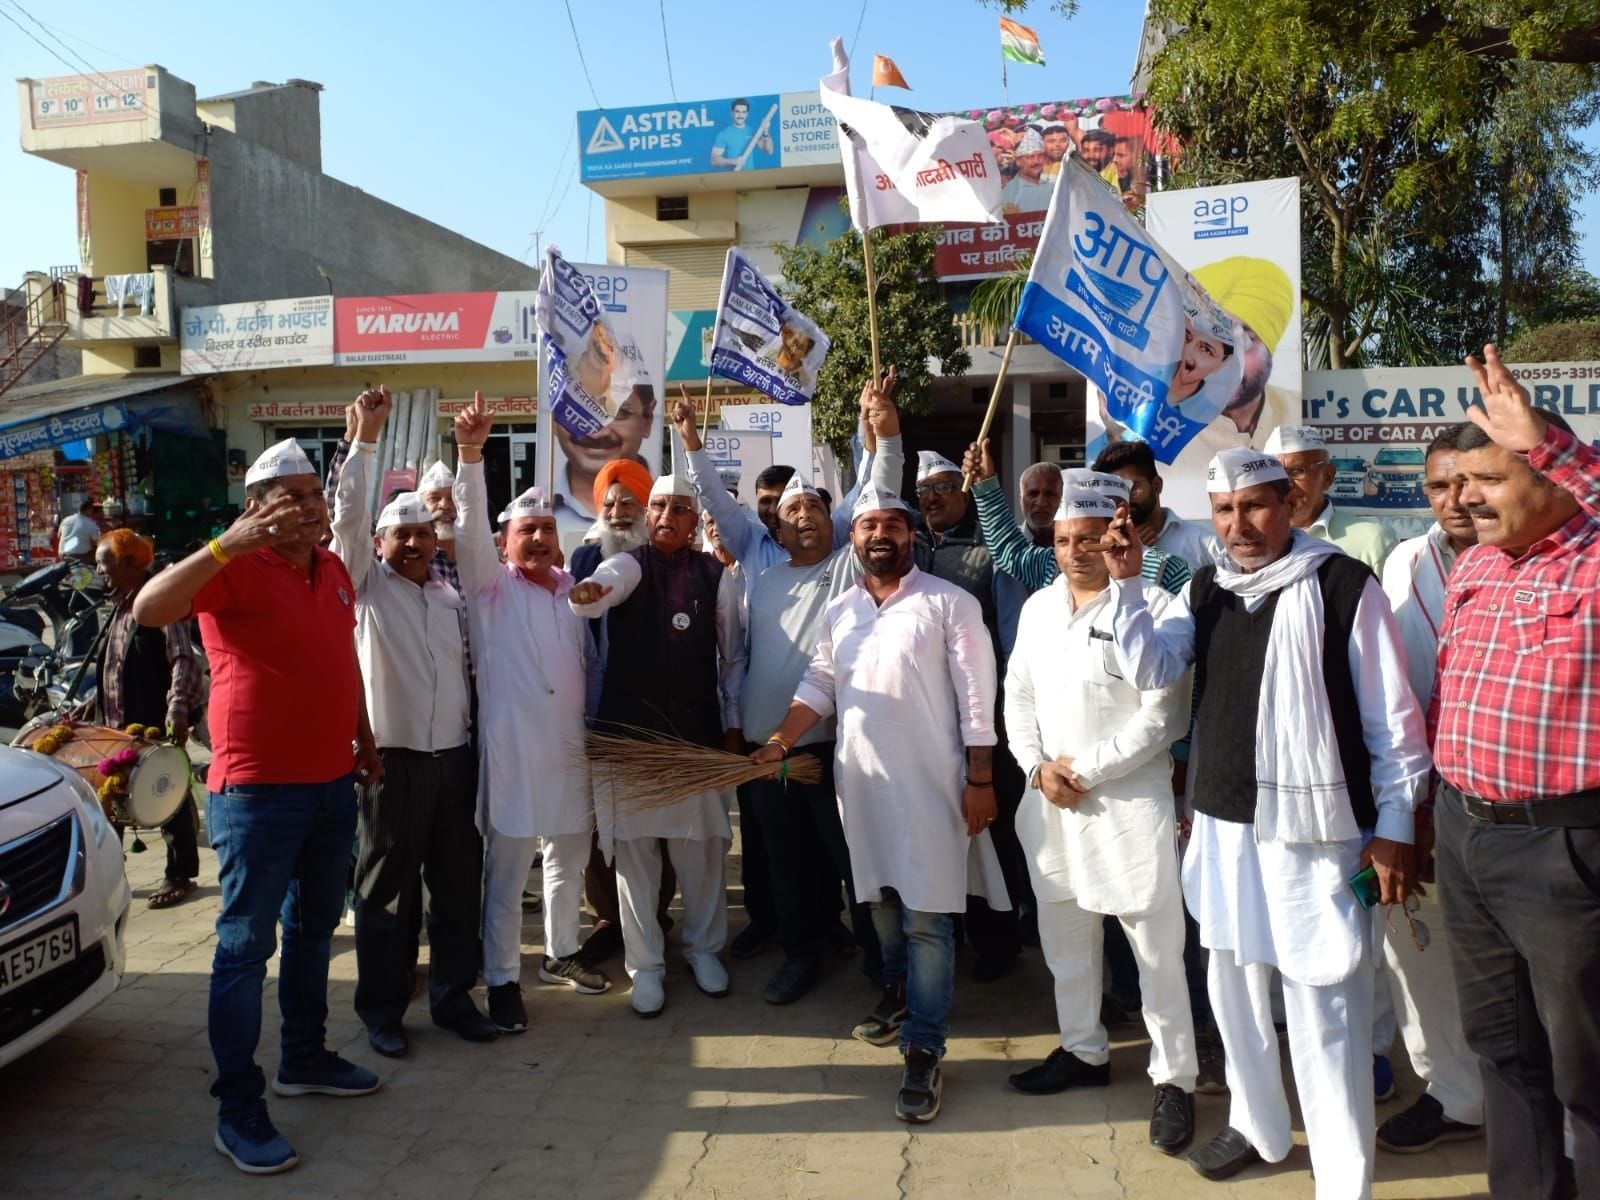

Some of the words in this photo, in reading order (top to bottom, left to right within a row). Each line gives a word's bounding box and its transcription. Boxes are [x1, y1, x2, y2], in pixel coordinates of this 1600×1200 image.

[621, 107, 714, 134] ASTRAL
[629, 133, 682, 151] PIPES
[792, 130, 831, 142] STORE
[1194, 196, 1248, 228] aap
[960, 251, 981, 265] पर
[356, 311, 459, 335] VARUNA
[1045, 314, 1102, 366] आम
[1362, 387, 1446, 419] CAR
[1457, 383, 1600, 416] WRL
[749, 411, 782, 433] aap
[1349, 427, 1374, 441] OF
[1378, 426, 1416, 441] CAR
[705, 436, 741, 460] aap
[1242, 459, 1268, 473] आम
[1074, 500, 1098, 509] आम
